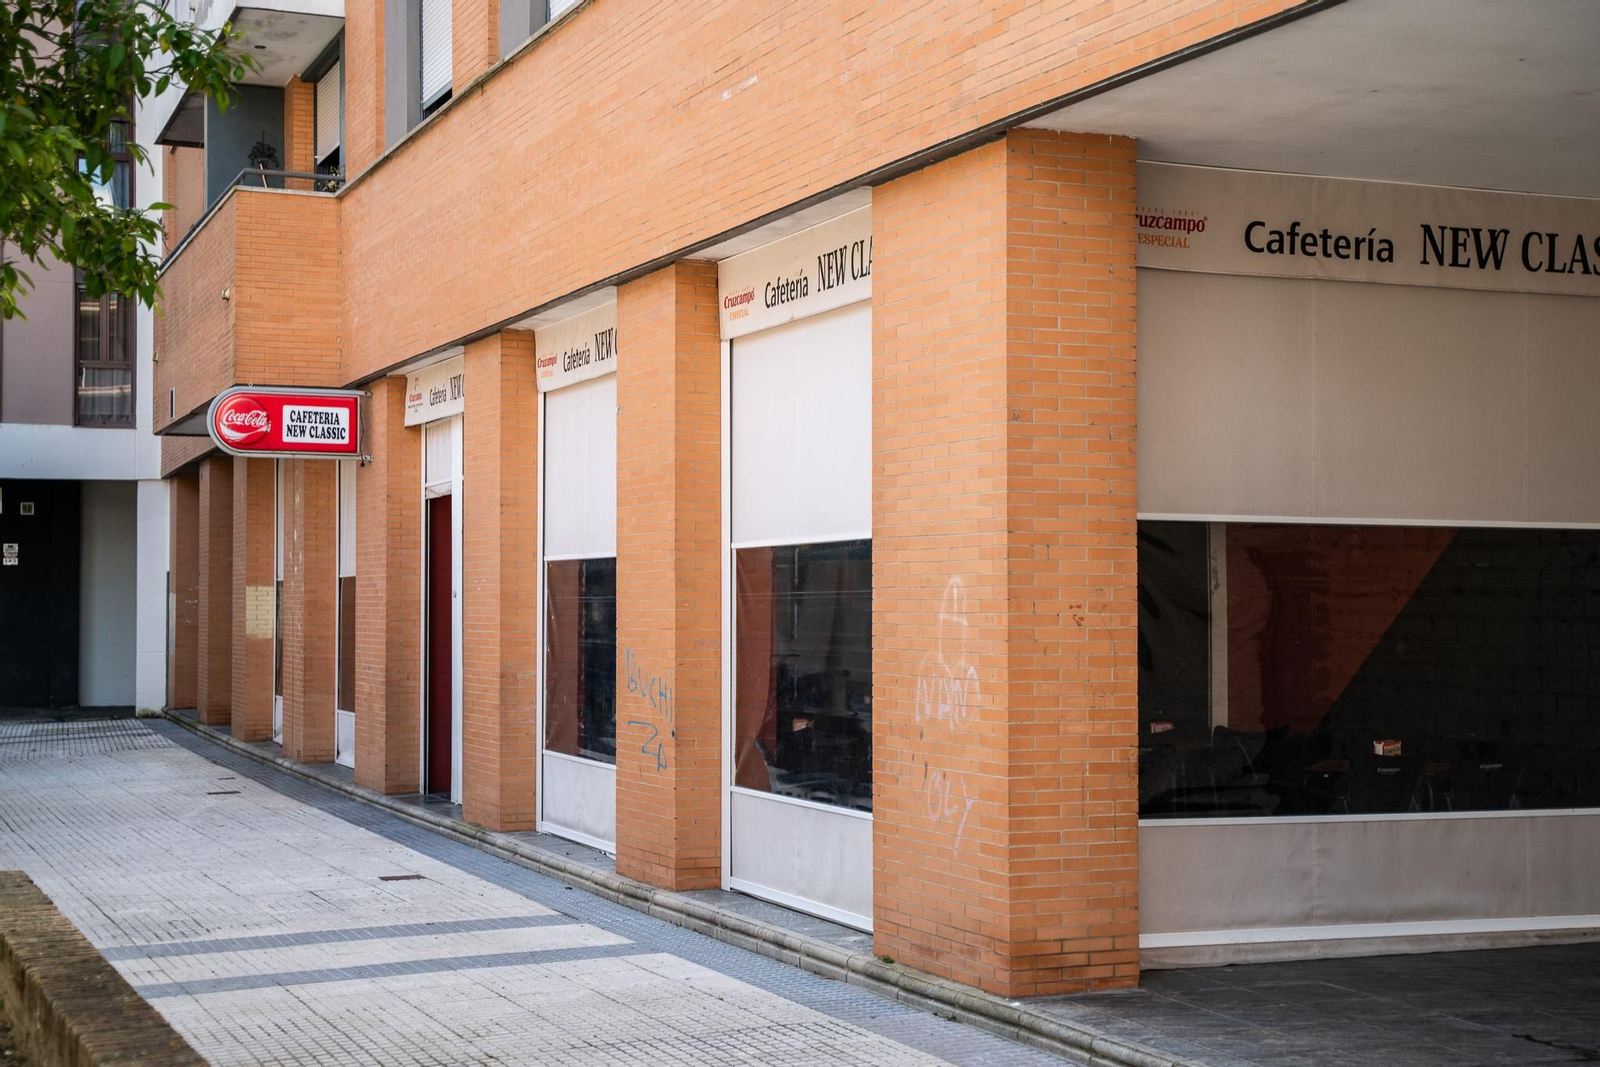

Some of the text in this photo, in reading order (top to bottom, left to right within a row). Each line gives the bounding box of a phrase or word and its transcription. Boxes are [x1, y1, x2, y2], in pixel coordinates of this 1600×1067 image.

[1137, 232, 1191, 249] ESPECIAL
[1244, 220, 1395, 264] Cafetería
[1420, 223, 1511, 271] NEW
[764, 269, 809, 309] Cafetería
[817, 244, 848, 293] NEW
[723, 289, 755, 310] Cruzcampo
[562, 342, 591, 373] Cafetería
[594, 327, 614, 363] NEW
[222, 409, 268, 427] Coca-Cola
[290, 409, 340, 426] CAFETERIA
[286, 424, 346, 440] NEW CLASSIC
